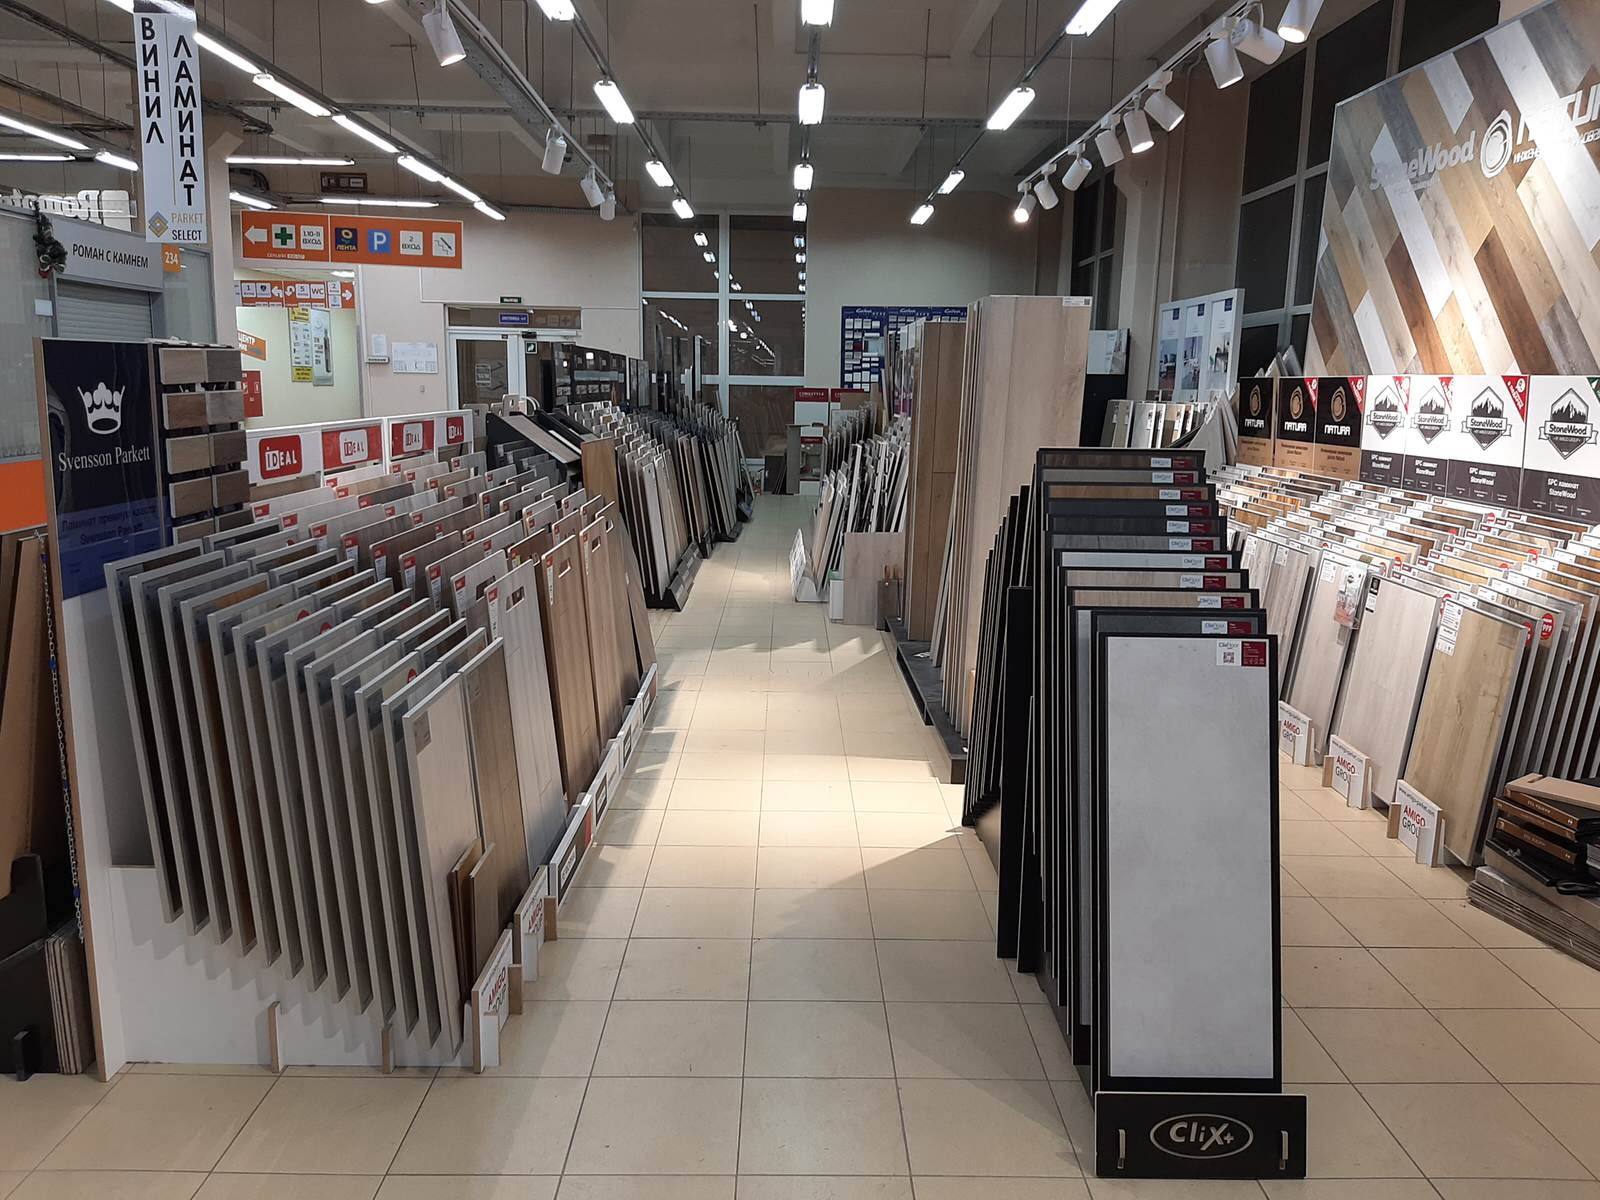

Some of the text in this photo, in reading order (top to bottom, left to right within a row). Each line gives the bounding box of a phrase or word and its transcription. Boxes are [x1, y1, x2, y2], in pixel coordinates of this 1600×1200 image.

[140, 17, 165, 144] ВИНИЛ
[173, 34, 199, 207] ЛАМИНАТ
[171, 212, 204, 224] PARKET
[171, 229, 202, 241] SELECT
[72, 243, 149, 269] РОМАН С КАМНЕМ
[164, 251, 179, 265] 234
[1373, 413, 1399, 421] StoneWood
[1417, 416, 1445, 424] StoneWood
[1470, 418, 1503, 429] StoneWood
[1284, 421, 1307, 433] NATURA
[1324, 424, 1351, 436] NATURA
[1549, 423, 1587, 436] StoneWood
[58, 445, 151, 472] Svensson Parkett
[1547, 478, 1558, 486] SPC
[1283, 719, 1301, 736] AMIGO
[1282, 728, 1294, 743] GRO
[1336, 755, 1356, 775] AMIGO
[1335, 766, 1348, 782] GRO
[1403, 804, 1426, 828] AMIGO
[487, 965, 506, 1011] AMIGO
